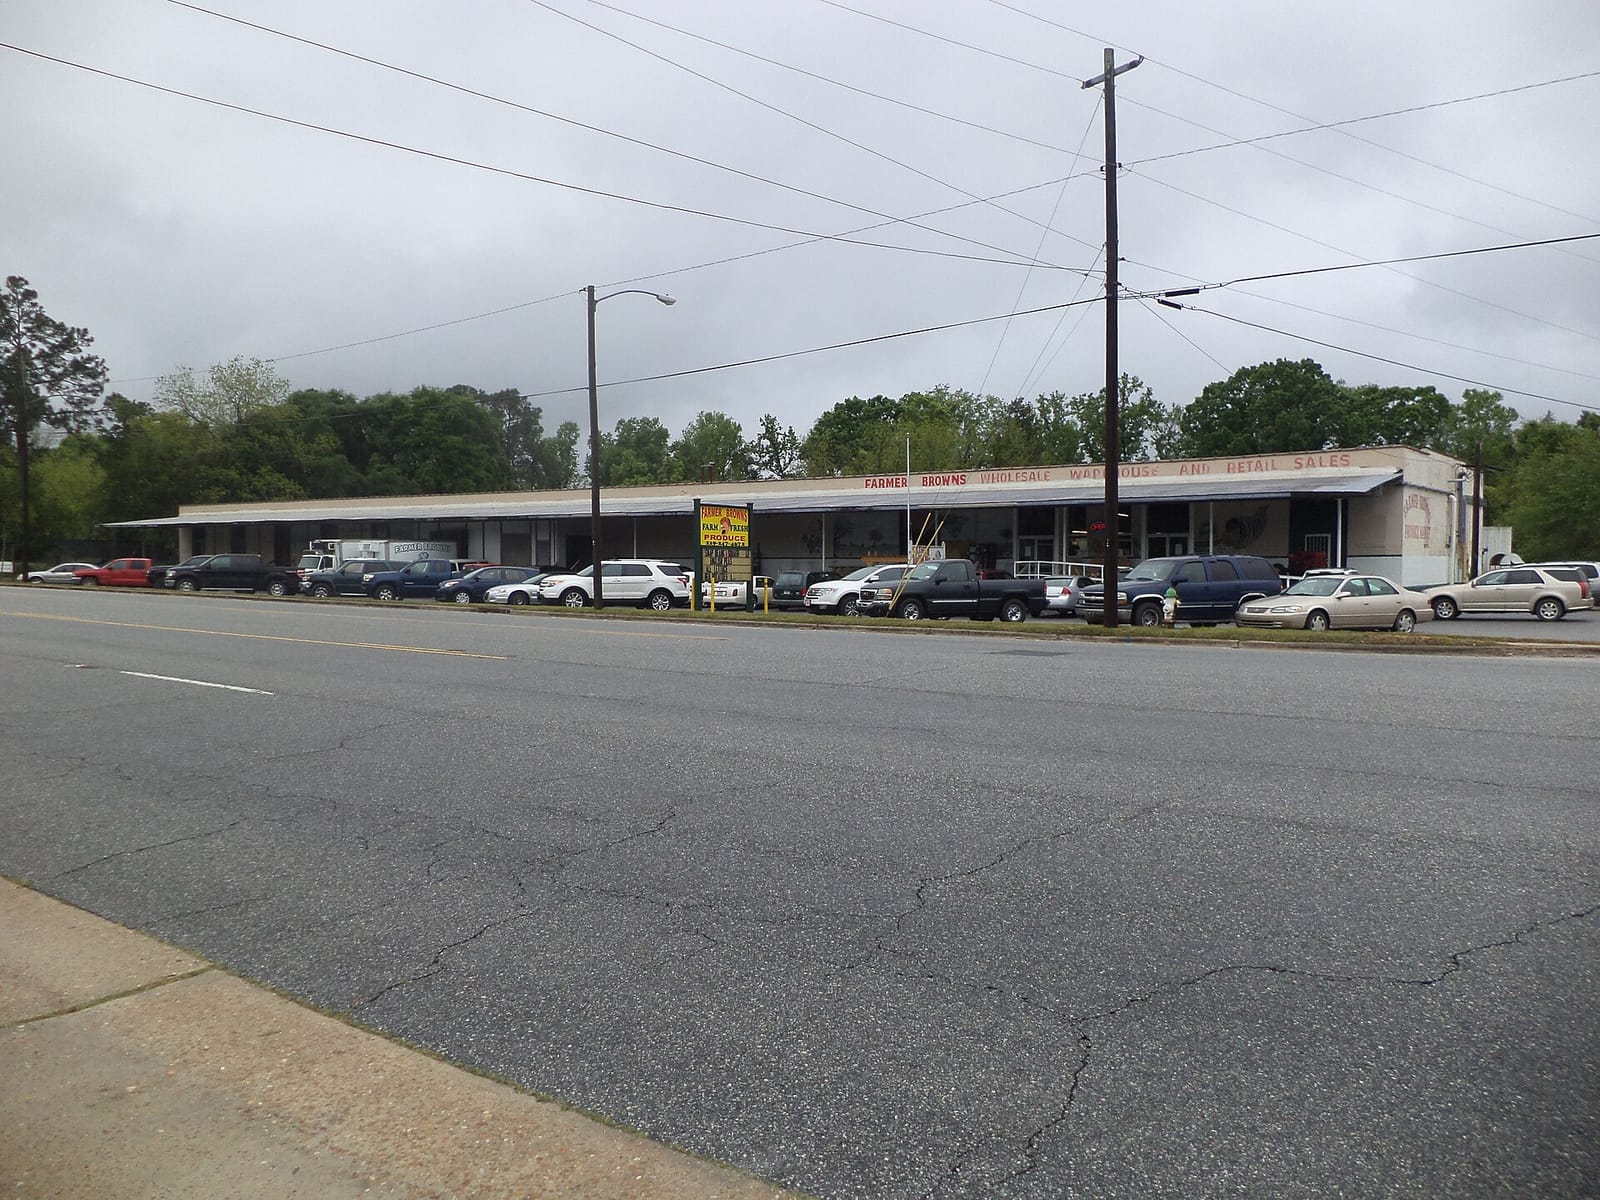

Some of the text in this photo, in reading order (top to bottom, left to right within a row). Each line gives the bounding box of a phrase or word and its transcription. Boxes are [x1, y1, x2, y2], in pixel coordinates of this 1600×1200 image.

[864, 477, 908, 489] FARMER
[922, 474, 967, 487] BROWNS
[980, 471, 1051, 484] WHOLESALE
[1179, 463, 1210, 476] AND
[1227, 459, 1278, 473] RETAIL
[1294, 454, 1350, 470] SALES
[702, 506, 748, 523] FARMER BROWNS
[702, 523, 719, 531] FARM
[704, 534, 746, 542] PRODUCE
